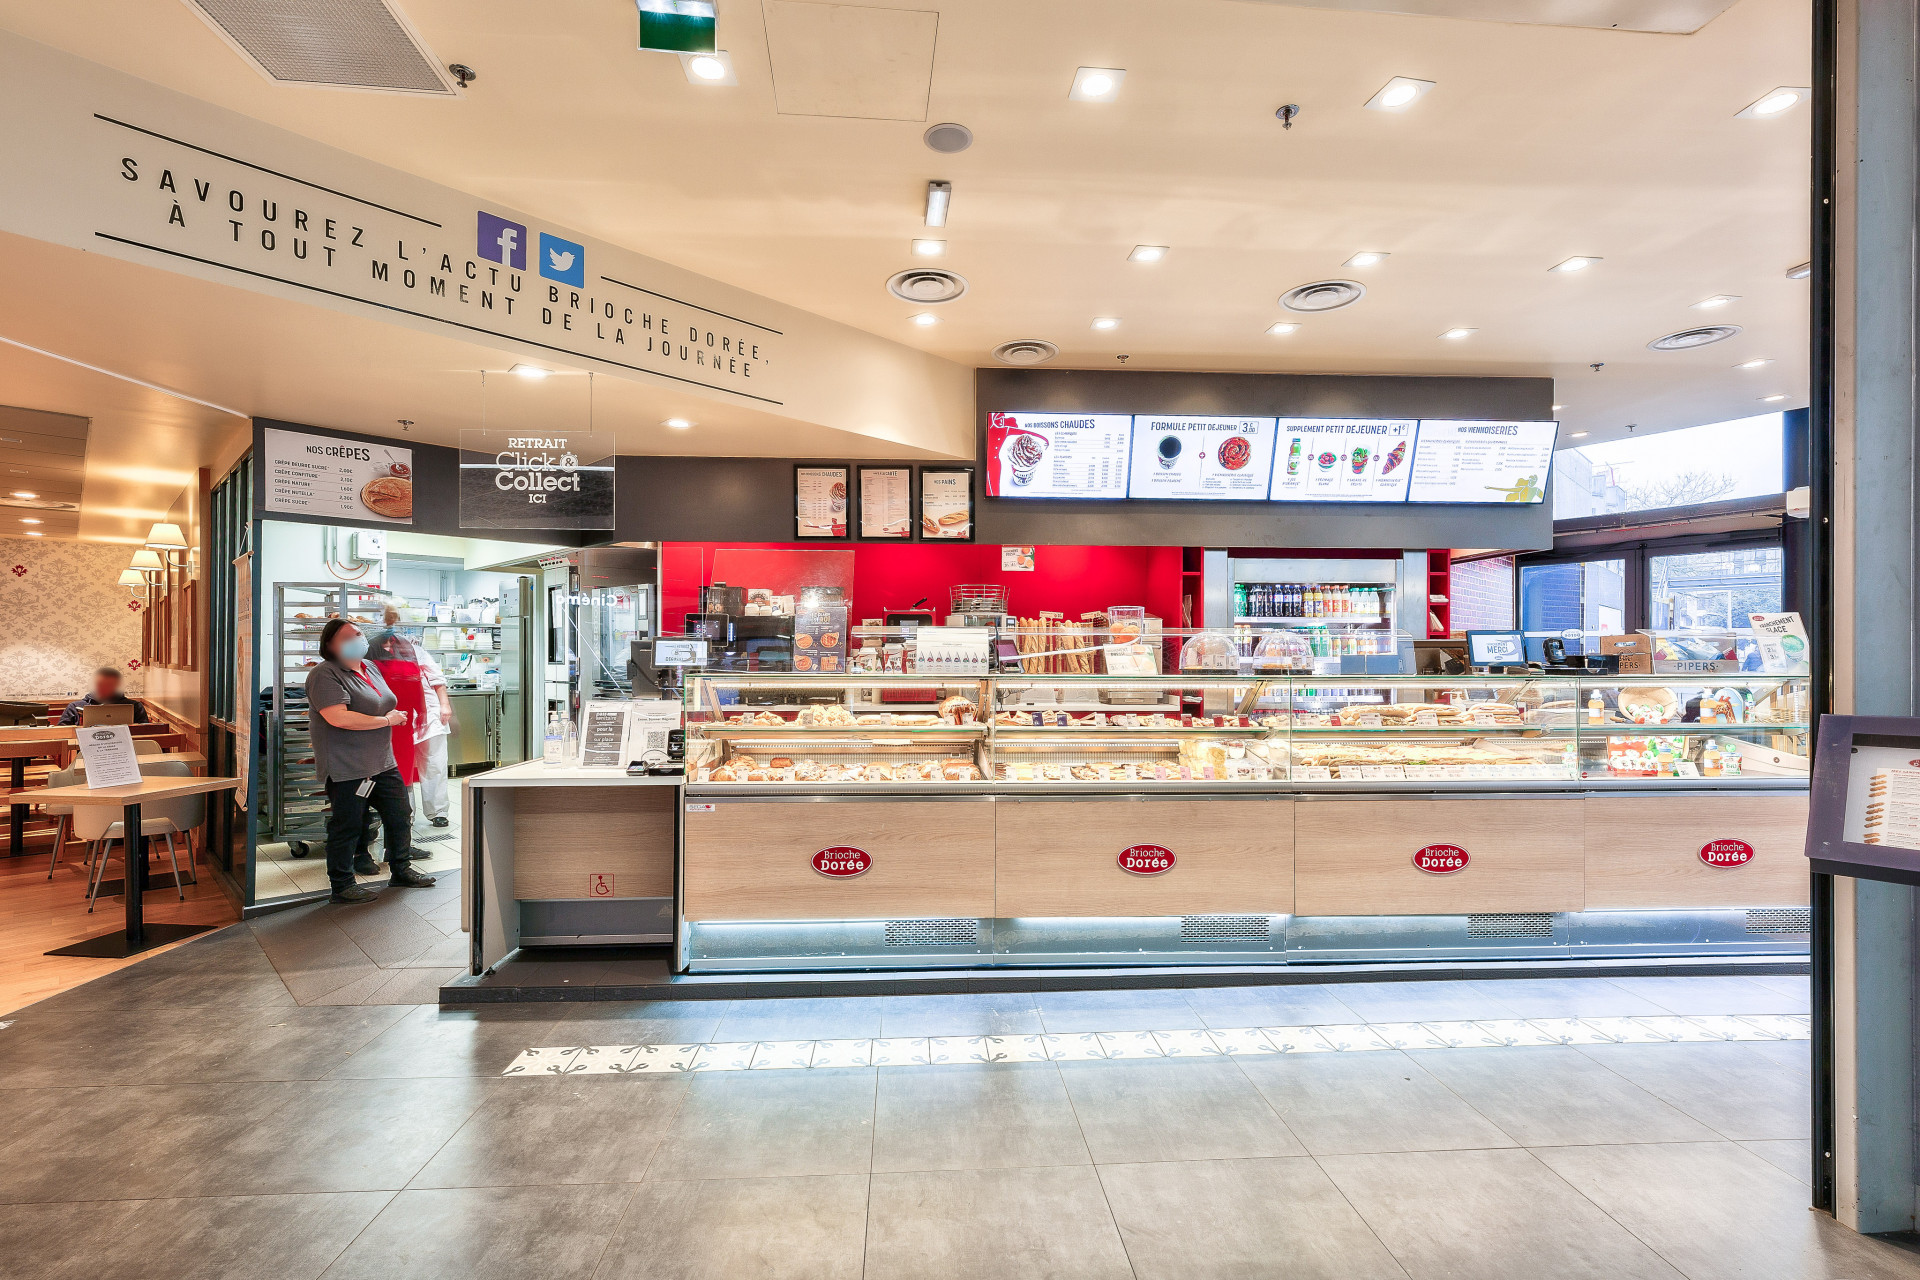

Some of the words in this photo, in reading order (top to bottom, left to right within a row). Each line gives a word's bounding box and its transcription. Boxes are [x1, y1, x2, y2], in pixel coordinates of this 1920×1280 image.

[120, 157, 364, 248] SAVOUREZ
[397, 240, 522, 293] L'ACTU
[548, 286, 669, 335] BRIOCHE
[689, 326, 770, 366] DORÉE,
[168, 199, 186, 228] À
[228, 219, 337, 268] TOUT
[371, 260, 515, 315] MOMENT
[542, 307, 572, 332] DE
[597, 322, 625, 346] LA
[646, 336, 752, 378] JOURNÉE
[1060, 418, 1096, 429] CHAUDES
[1151, 421, 1187, 431] FORMULE
[1188, 422, 1207, 431] PETIT
[1325, 424, 1345, 434] PETIT
[507, 437, 568, 449] RETRAIT
[306, 445, 323, 455] NOS
[325, 445, 371, 461] CRÊPES
[496, 451, 557, 472] Click
[495, 471, 581, 492] Collect
[528, 493, 547, 504] ICI
[1486, 645, 1509, 654] MERCI
[1129, 848, 1166, 857] Brioche
[1424, 847, 1460, 857] Brioche
[1710, 842, 1745, 852] Brioche
[823, 850, 861, 860] Brioche
[1707, 852, 1748, 862] Dorée
[820, 860, 864, 871] Dorée
[1126, 857, 1169, 868] Dorée
[1421, 857, 1463, 868] Dorée
